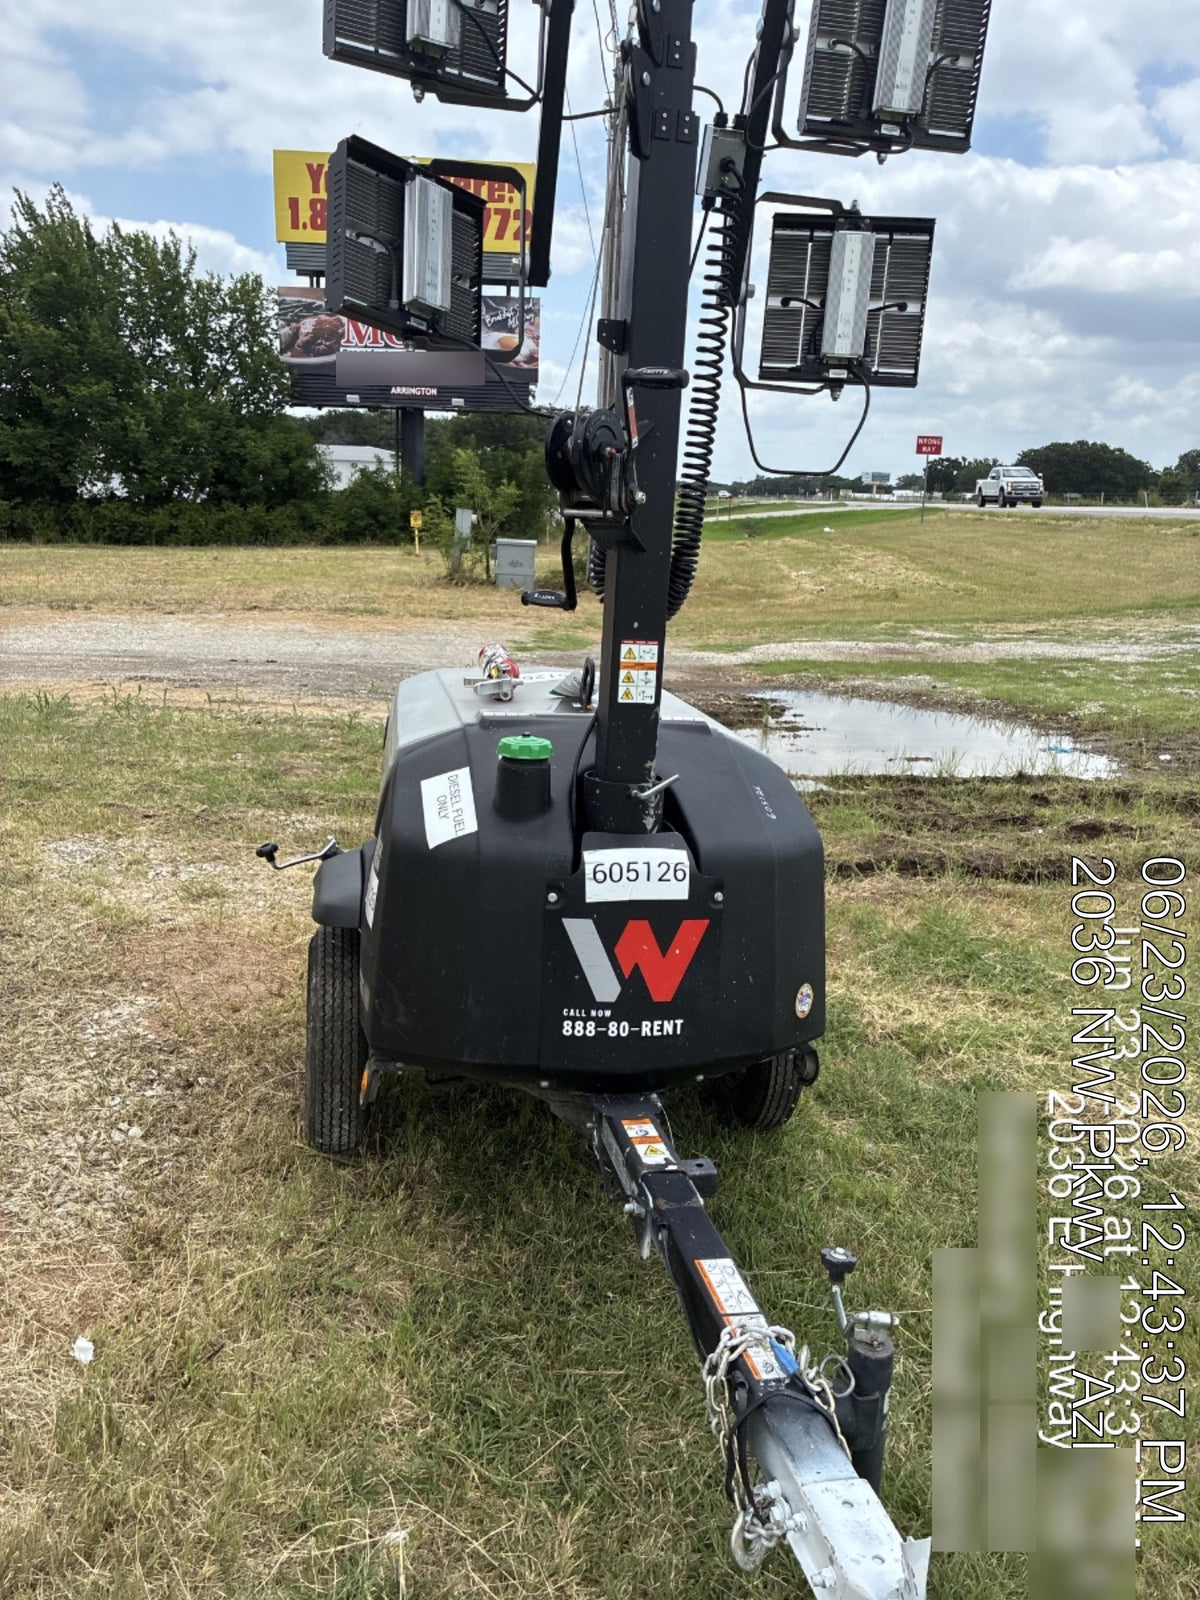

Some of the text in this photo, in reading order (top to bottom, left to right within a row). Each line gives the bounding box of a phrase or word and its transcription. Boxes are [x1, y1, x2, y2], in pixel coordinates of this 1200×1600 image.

[390, 386, 438, 396] ARRINGTON
[918, 438, 941, 446] WRONG
[436, 794, 449, 820] ONLY
[447, 774, 465, 836] DIESEL FUEL
[592, 861, 687, 884] 605126
[563, 1008, 611, 1018] CALL NOW
[562, 1019, 684, 1037] 888-80-RENT
